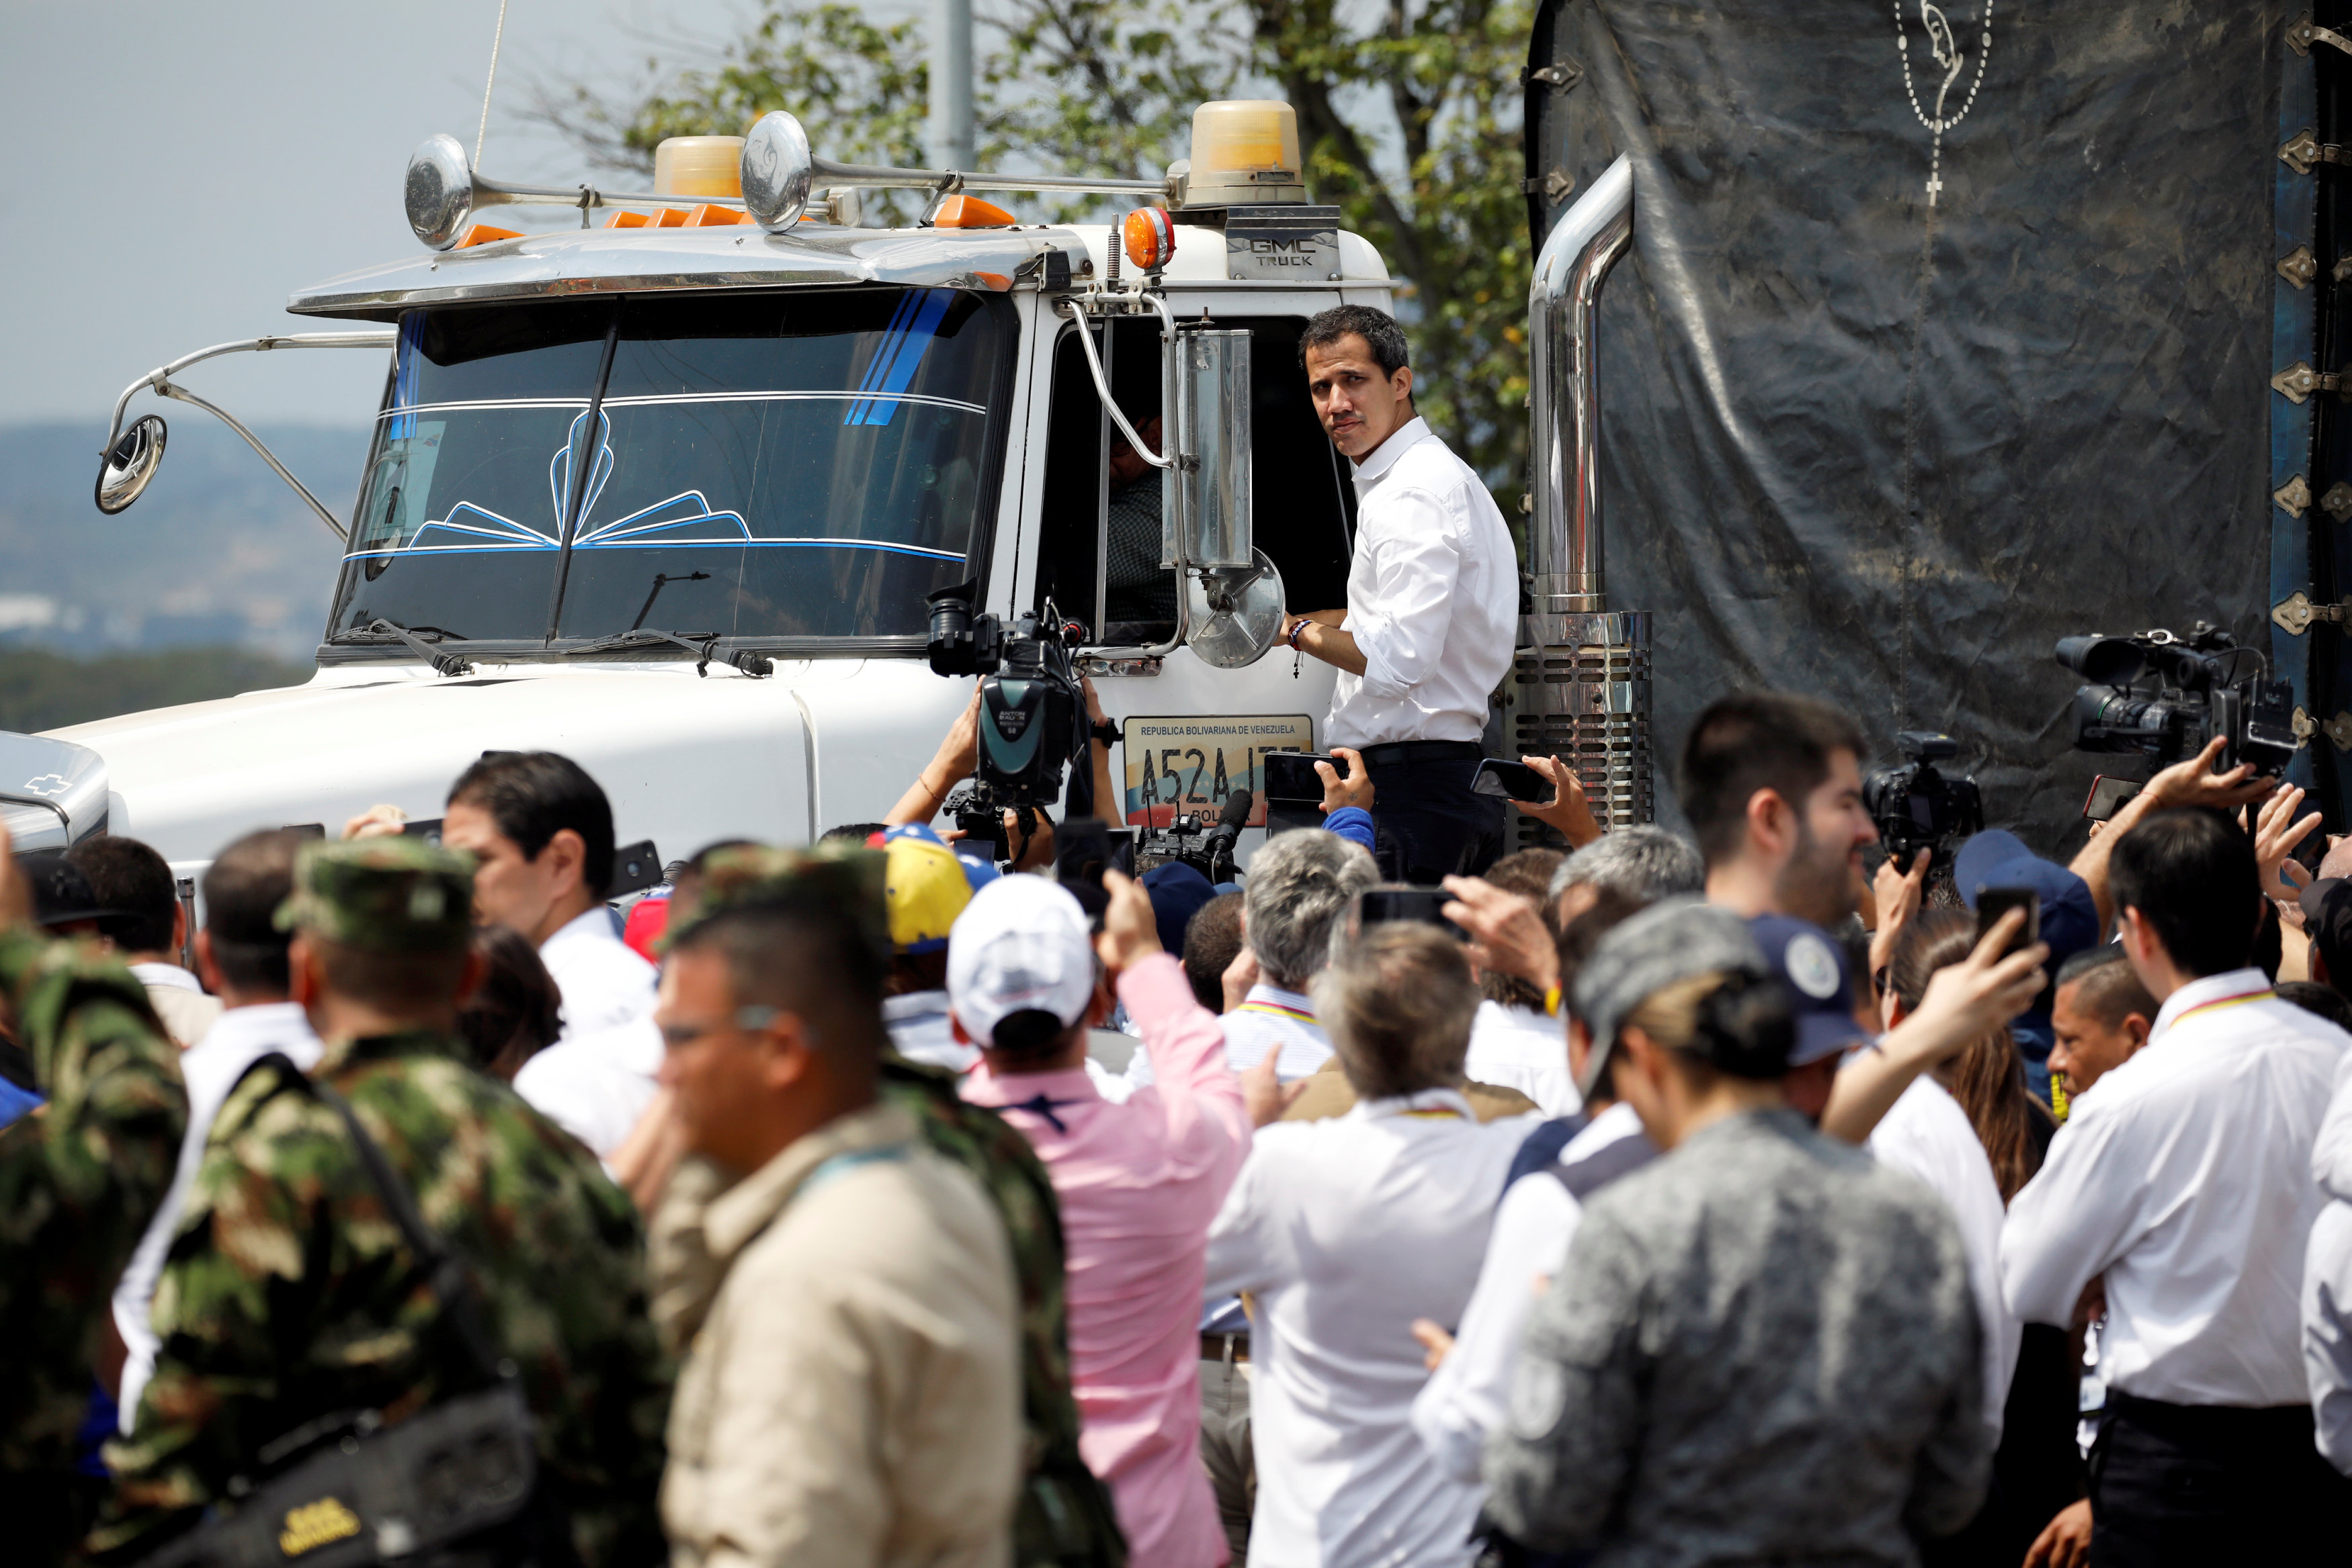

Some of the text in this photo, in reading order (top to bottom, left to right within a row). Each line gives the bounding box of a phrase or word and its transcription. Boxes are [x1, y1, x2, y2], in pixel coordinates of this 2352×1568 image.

[1250, 238, 1316, 253] GMC
[1256, 257, 1312, 266] TRUCK
[1141, 725, 1295, 736] REPUBLICA BOLIVARIANA DE VENEZUELA
